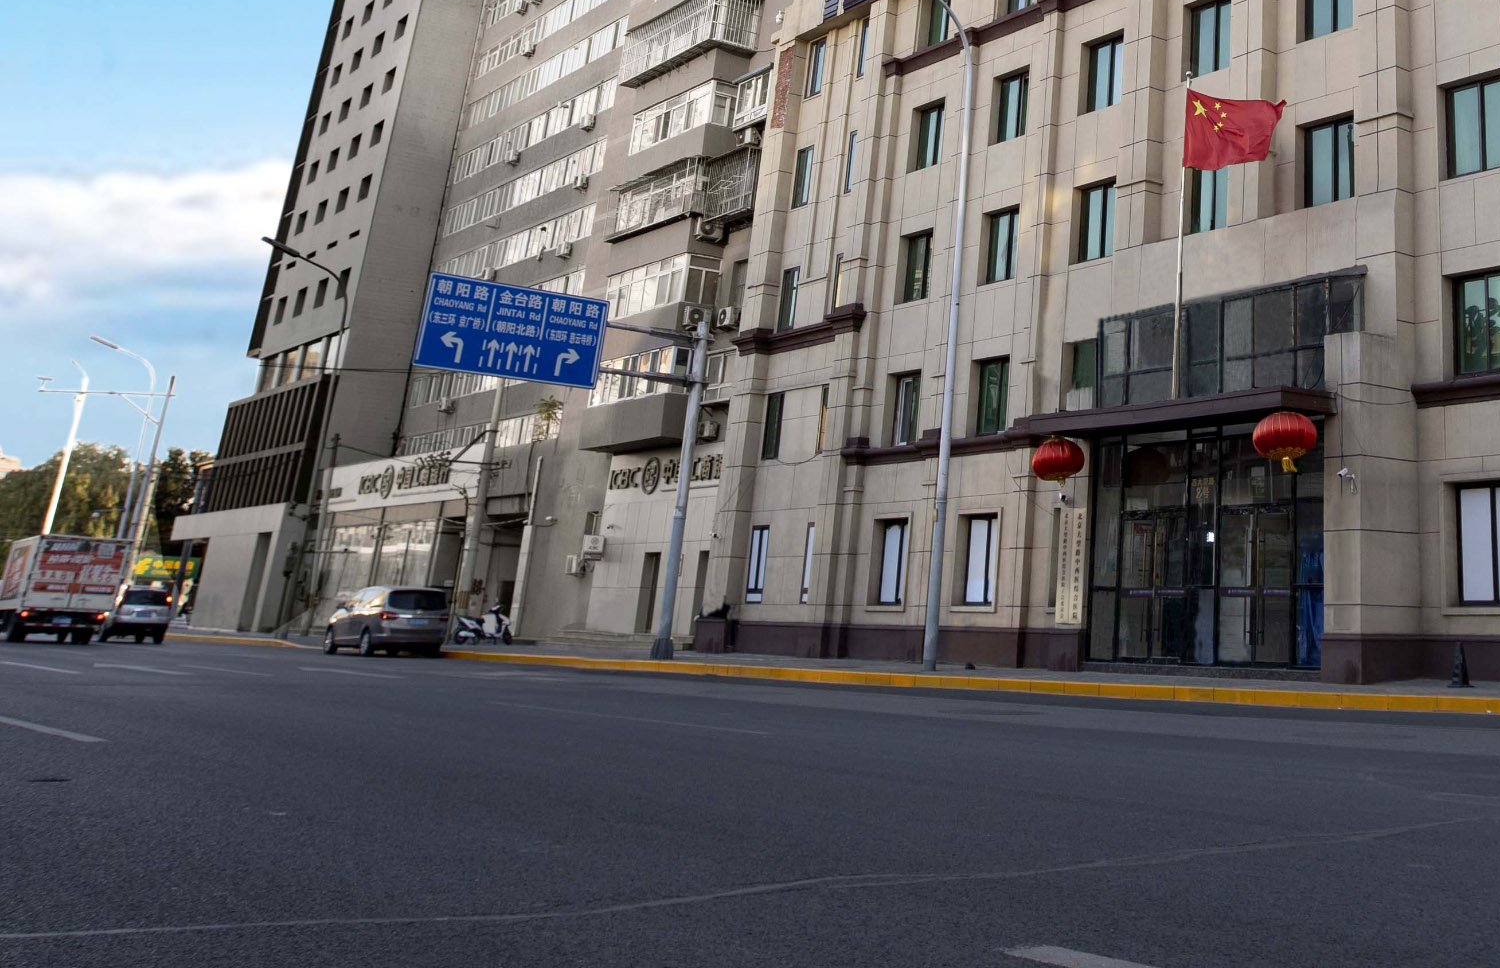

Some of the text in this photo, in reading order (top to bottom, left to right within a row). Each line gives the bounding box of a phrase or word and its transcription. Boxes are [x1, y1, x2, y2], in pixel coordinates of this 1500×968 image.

[437, 279, 489, 301] 朝阳路
[499, 290, 543, 310] 金台路
[434, 297, 487, 313] CHAOYANG Rd
[496, 308, 541, 322] JINTAI Rd
[552, 298, 600, 319] 朝阳路
[549, 315, 598, 330] CHAOYANG Rd
[608, 467, 641, 490] ICBC
